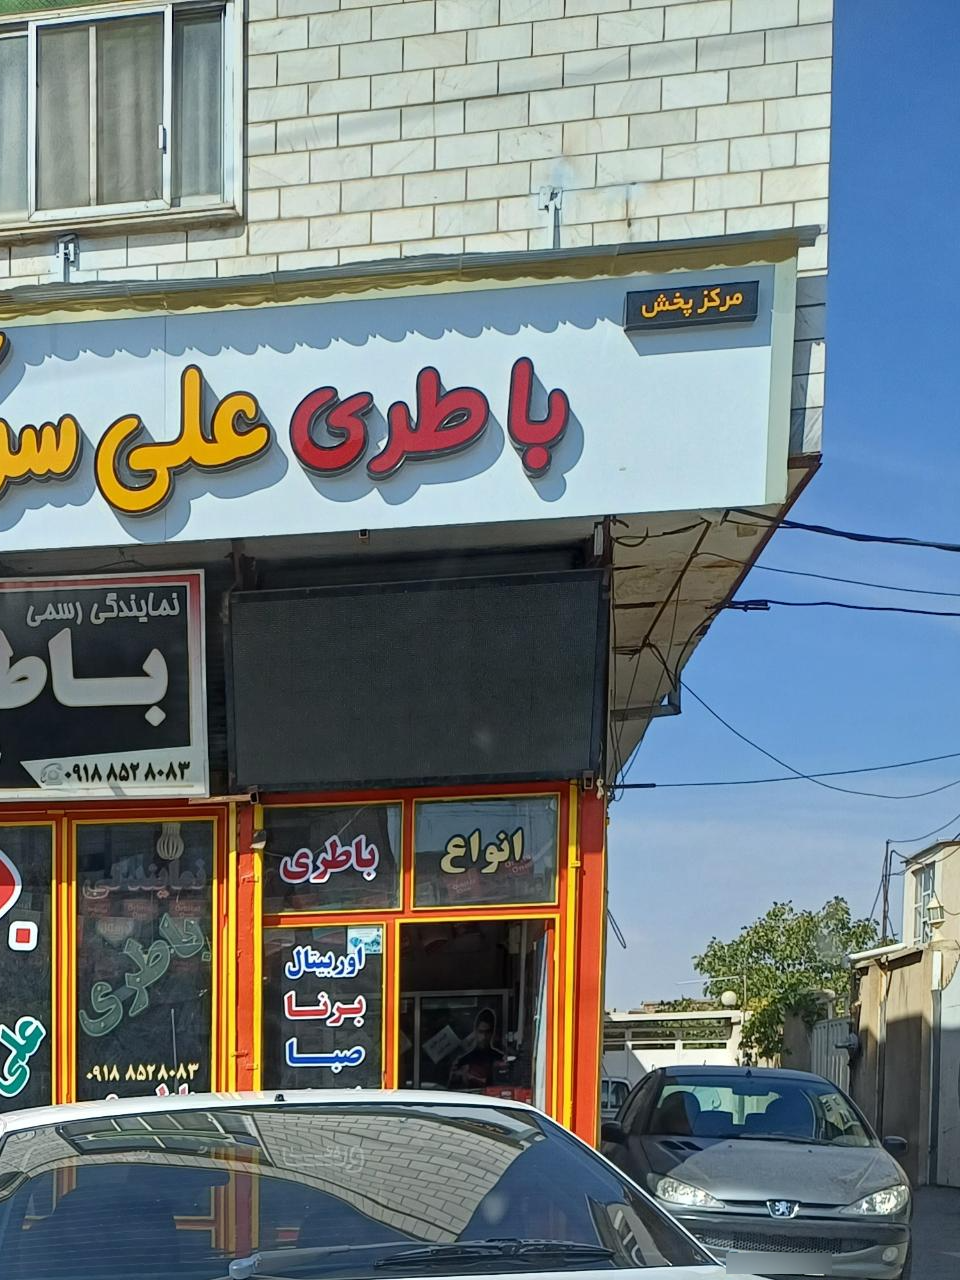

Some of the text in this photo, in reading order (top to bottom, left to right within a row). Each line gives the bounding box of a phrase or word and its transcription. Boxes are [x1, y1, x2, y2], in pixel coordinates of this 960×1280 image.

[641, 287, 743, 318] مرکز پخش
[290, 357, 570, 479] باطری
[94, 363, 271, 517] علی
[26, 592, 180, 627] نمایندگی رسمی
[64, 761, 191, 782] ۰۹۱۸ ۸۵۲ ۸۰۸۳
[280, 834, 379, 883] باطری
[440, 827, 524, 874] انواع
[79, 912, 212, 1037] باطری
[285, 946, 365, 980] اوربیتال
[284, 990, 366, 1028] برنا
[86, 1064, 120, 1081] ۰۹۱۸
[285, 1037, 366, 1074] صبا
